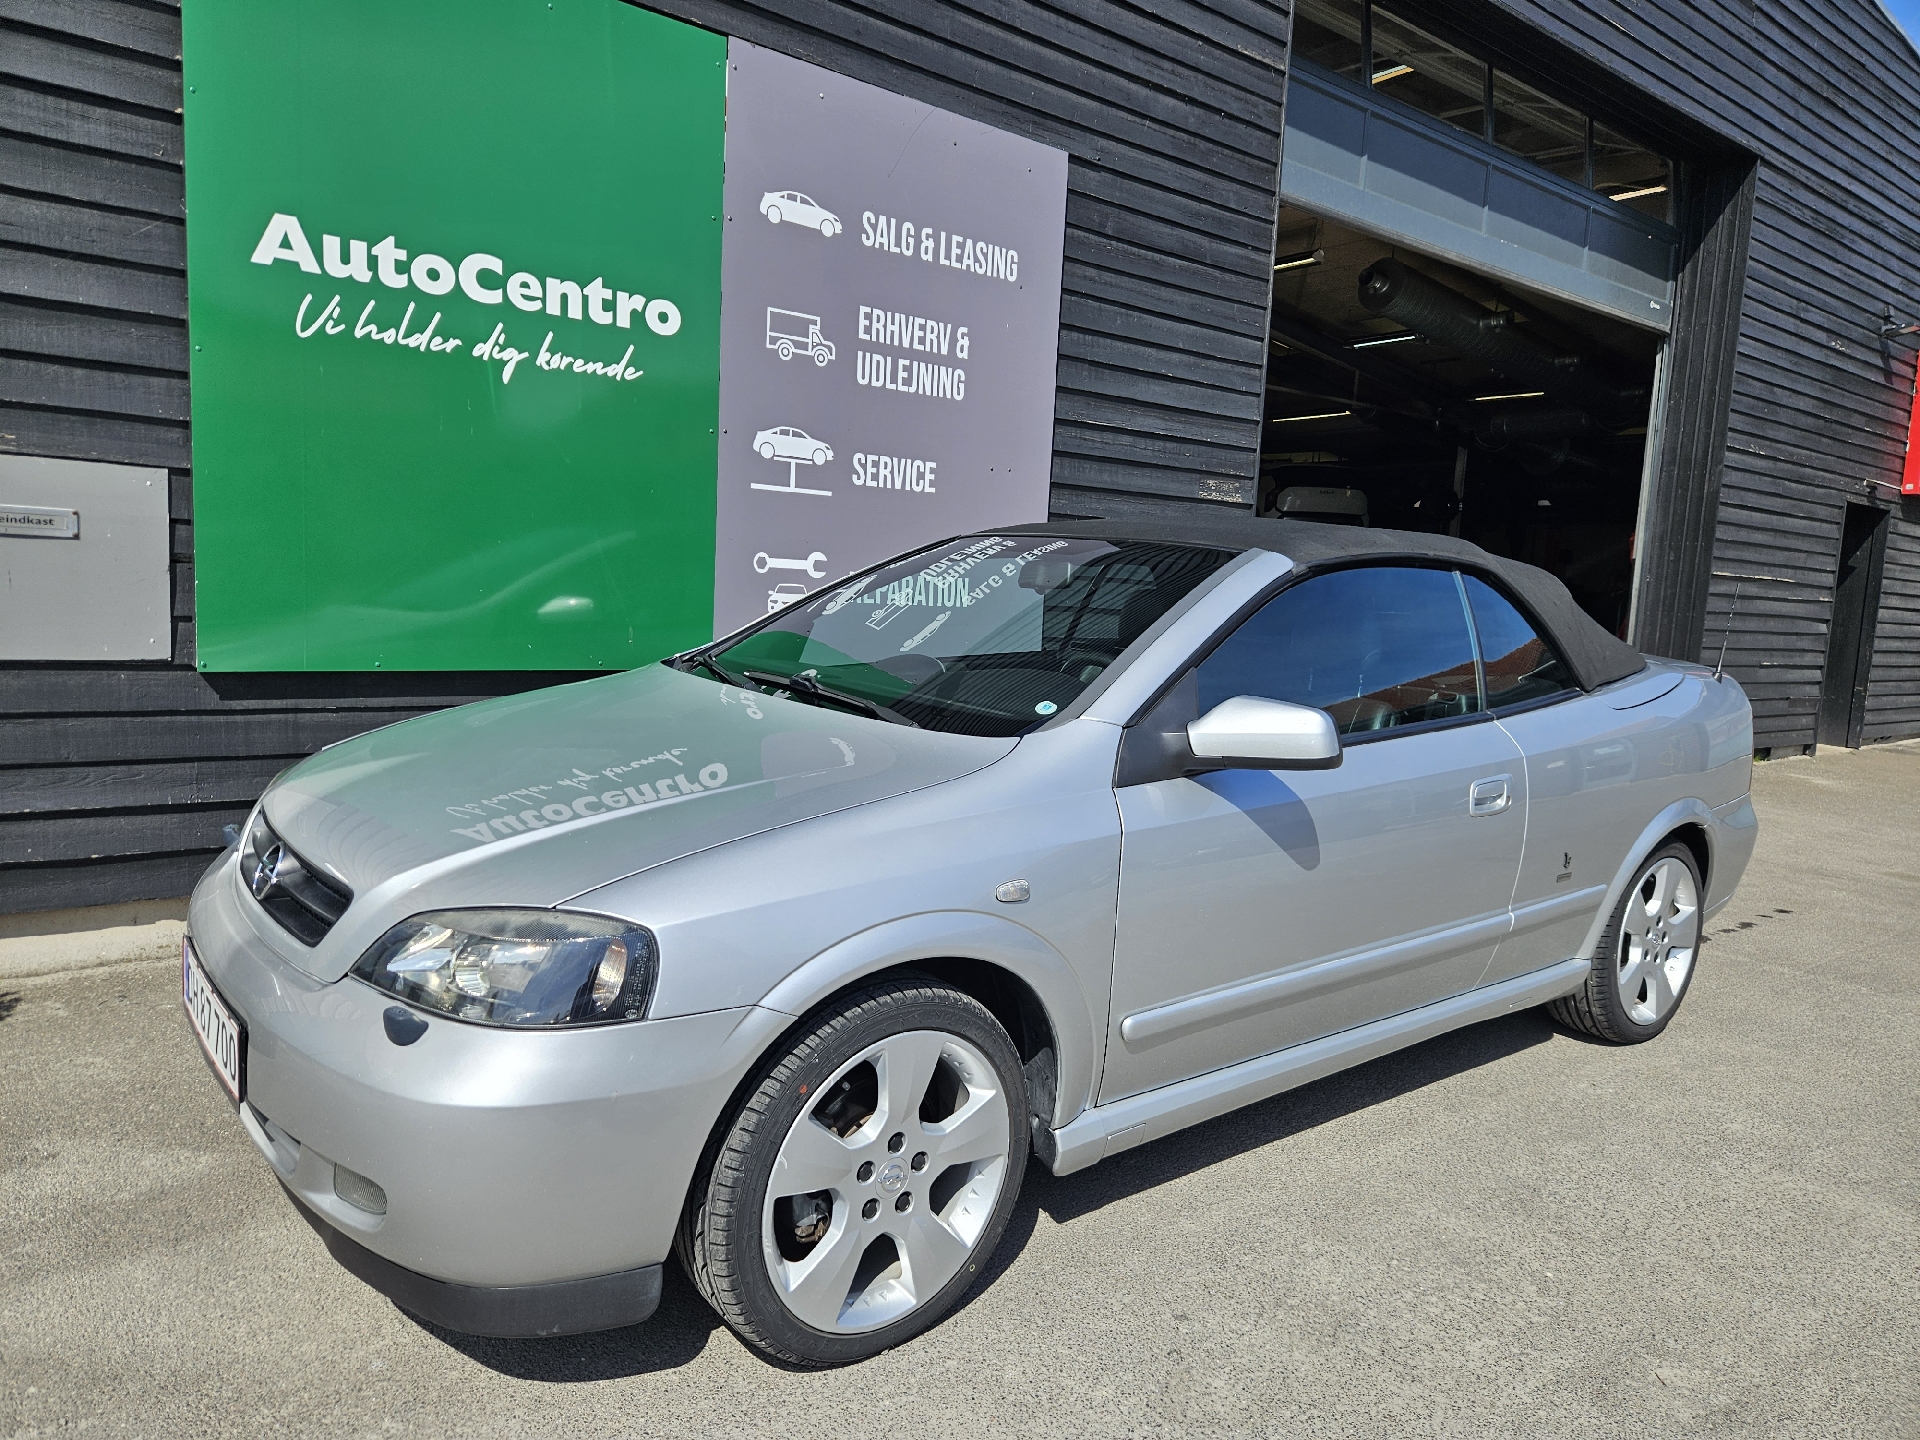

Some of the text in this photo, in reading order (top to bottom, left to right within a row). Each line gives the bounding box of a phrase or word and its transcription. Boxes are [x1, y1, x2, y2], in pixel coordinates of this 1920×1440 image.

[251, 213, 682, 336] AutoCentro
[861, 210, 1019, 283] SALG & LEASING
[295, 293, 644, 385] Vi holder dig kørende
[858, 304, 970, 360] ERHVERV &
[856, 350, 966, 401] UDLEJNING
[851, 452, 937, 494] SERVICE
[214, 1009, 236, 1081] 700
